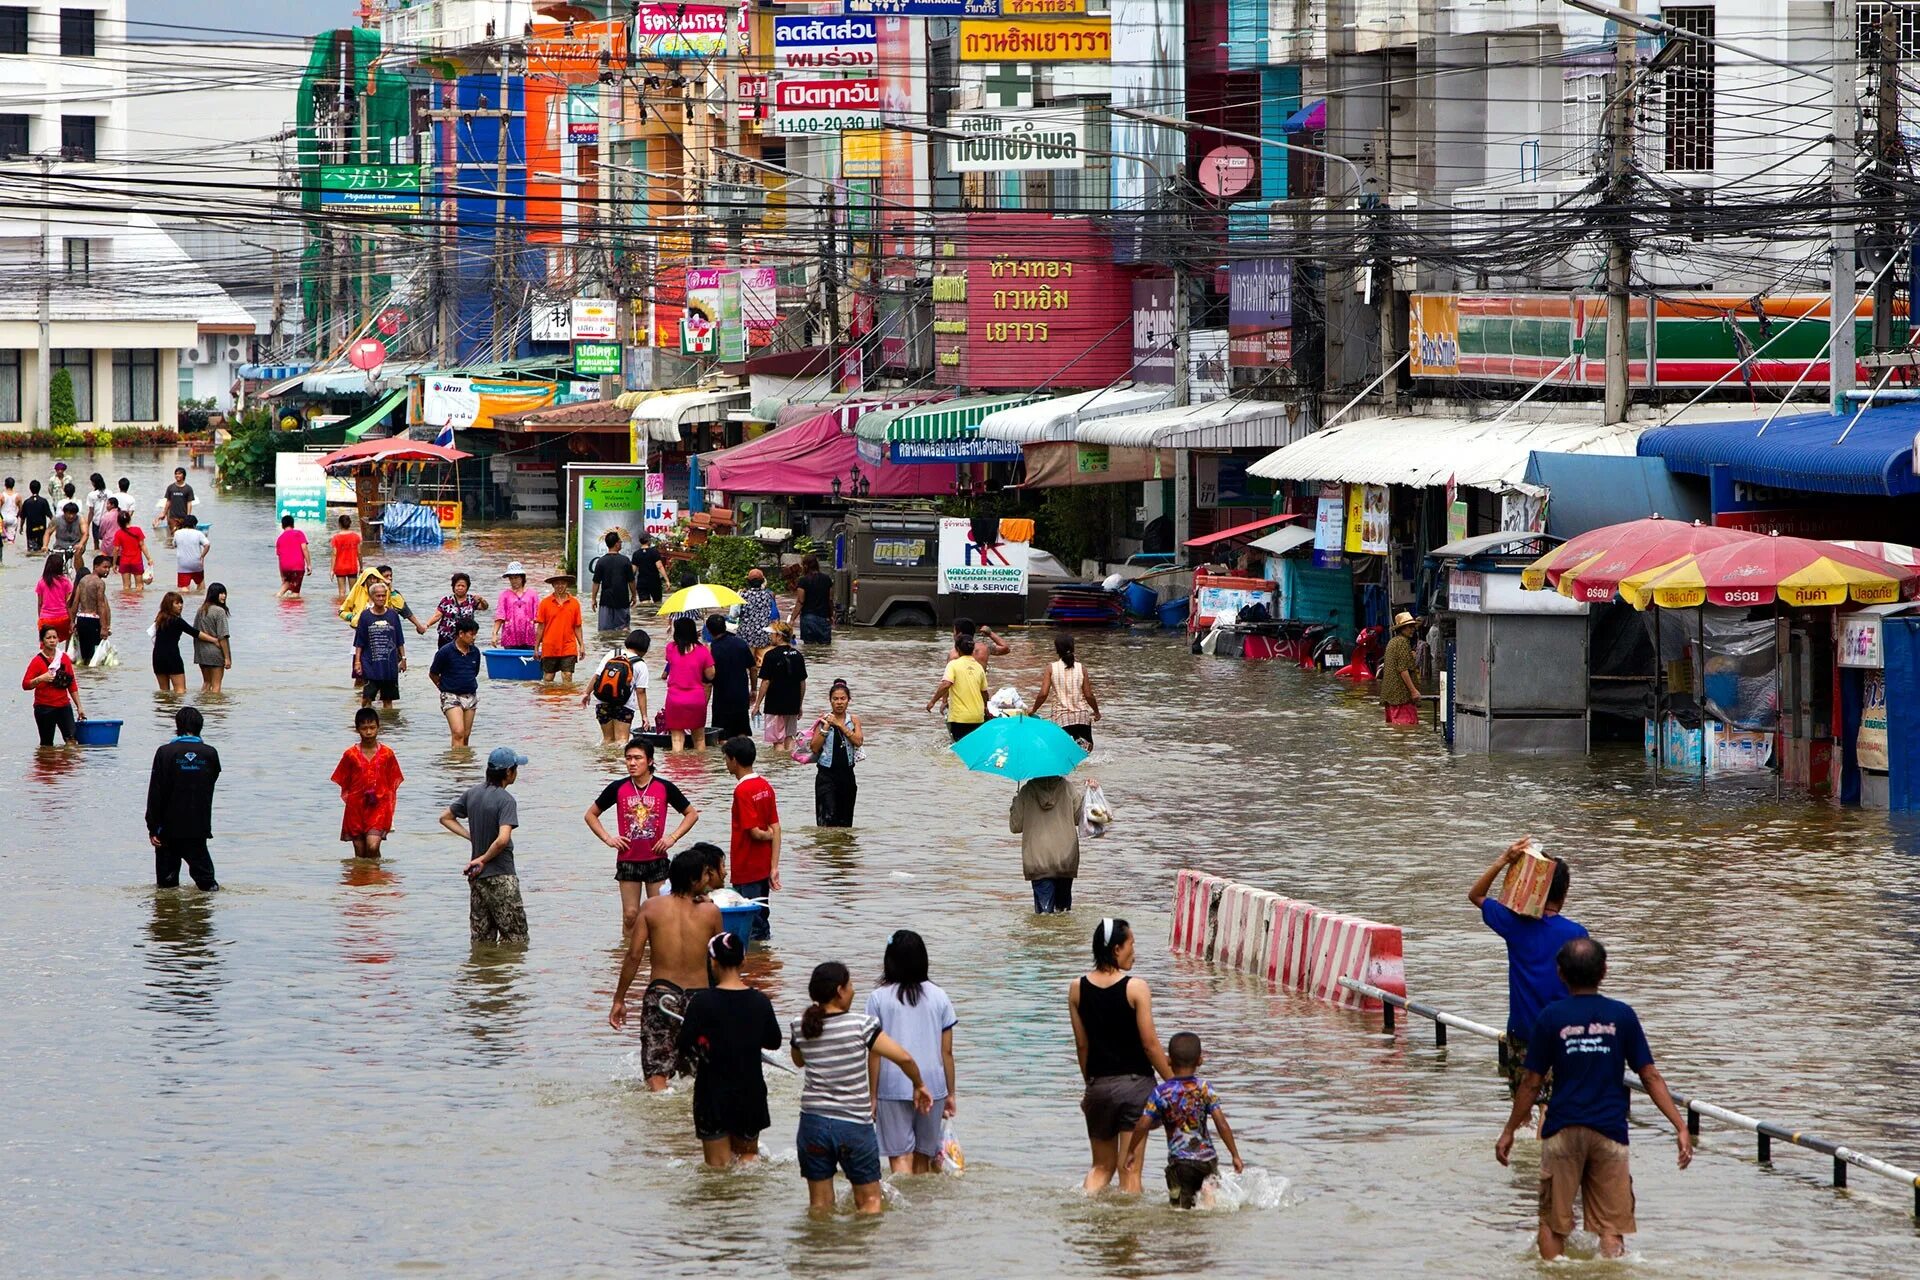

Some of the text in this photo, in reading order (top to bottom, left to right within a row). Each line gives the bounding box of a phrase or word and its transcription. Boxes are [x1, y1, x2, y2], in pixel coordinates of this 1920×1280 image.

[1013, 0, 1075, 12] หางทอง
[966, 27, 1110, 52] กวนอิมเยาวรา
[786, 47, 874, 67] ผมร่วง
[784, 83, 879, 108] เปิดทุกวัน
[779, 116, 864, 132] 11.00-2030
[325, 168, 416, 189] ペガサス
[993, 284, 1069, 310] กวนอิม
[982, 583, 1019, 592] SERVICE
[1586, 586, 1609, 598] อร่อย
[1724, 588, 1760, 602] อร่อย
[1854, 587, 1892, 600] ปลอดภัย
[1795, 588, 1827, 604] คุ้มค่า
